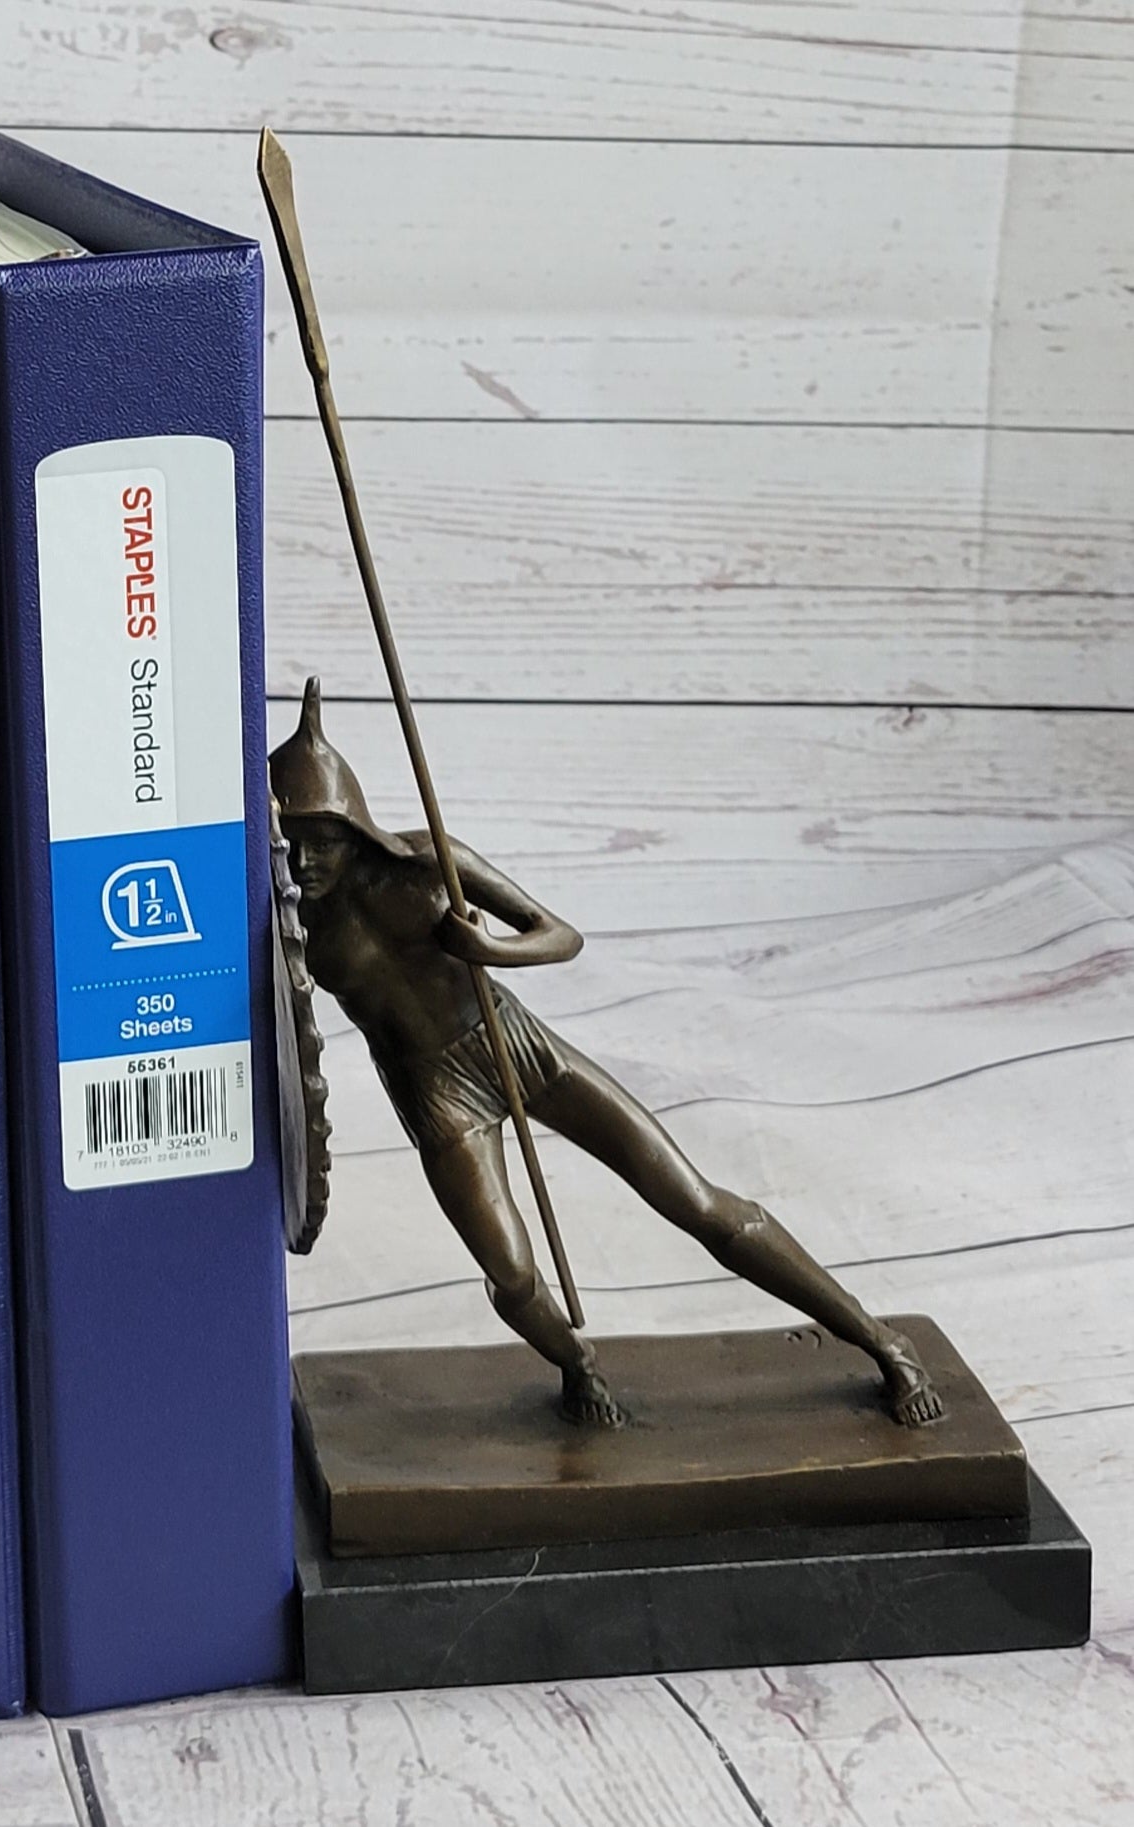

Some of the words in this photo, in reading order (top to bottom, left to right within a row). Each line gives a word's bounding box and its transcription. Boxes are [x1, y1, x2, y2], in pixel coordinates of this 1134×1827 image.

[122, 486, 157, 639] STAPLES
[130, 657, 164, 803] Standard
[165, 909, 177, 923] in
[137, 993, 175, 1015] 350
[120, 1015, 193, 1039] Sheets
[127, 1055, 175, 1074] 55361
[77, 1151, 84, 1161] 7
[109, 1143, 148, 1158] 18103
[167, 1135, 207, 1150] 32490
[230, 1131, 238, 1142] 8
